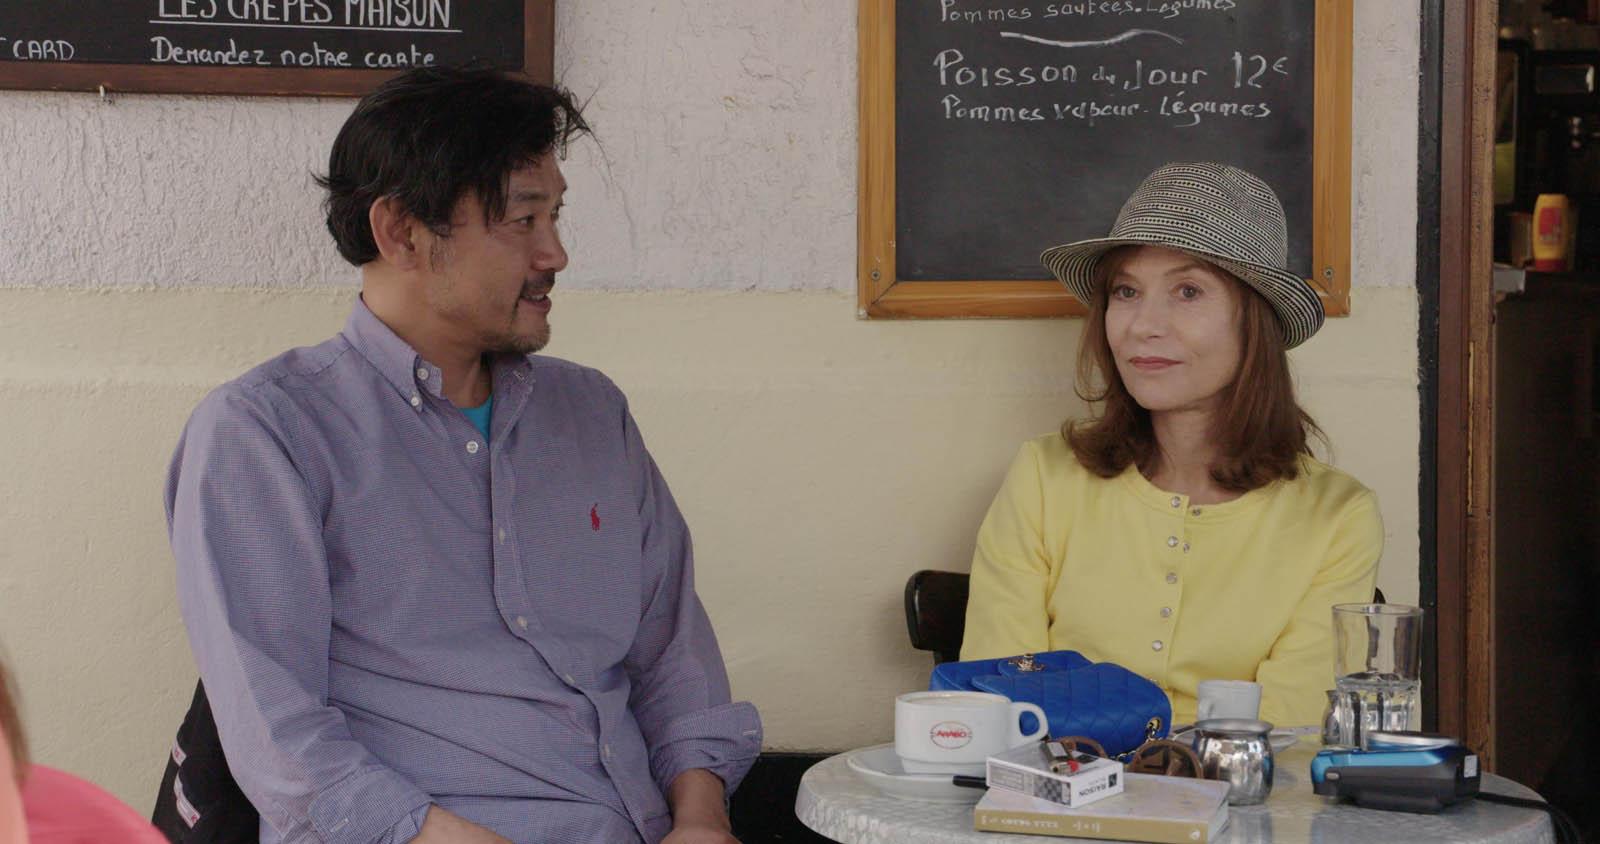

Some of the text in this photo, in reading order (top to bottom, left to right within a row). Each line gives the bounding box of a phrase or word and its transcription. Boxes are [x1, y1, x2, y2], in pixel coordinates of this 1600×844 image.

[158, 0, 218, 19] LES
[345, 0, 451, 29] MAISON
[940, 0, 1032, 23] Pommes
[12, 39, 75, 61] CARD
[150, 36, 272, 65] Demandez
[280, 41, 352, 67] notre
[933, 48, 1077, 87] Poisson
[1092, 66, 1116, 85] du
[1123, 59, 1208, 91] Jour
[941, 94, 1045, 122] Pommes
[1160, 91, 1272, 128] Légumes
